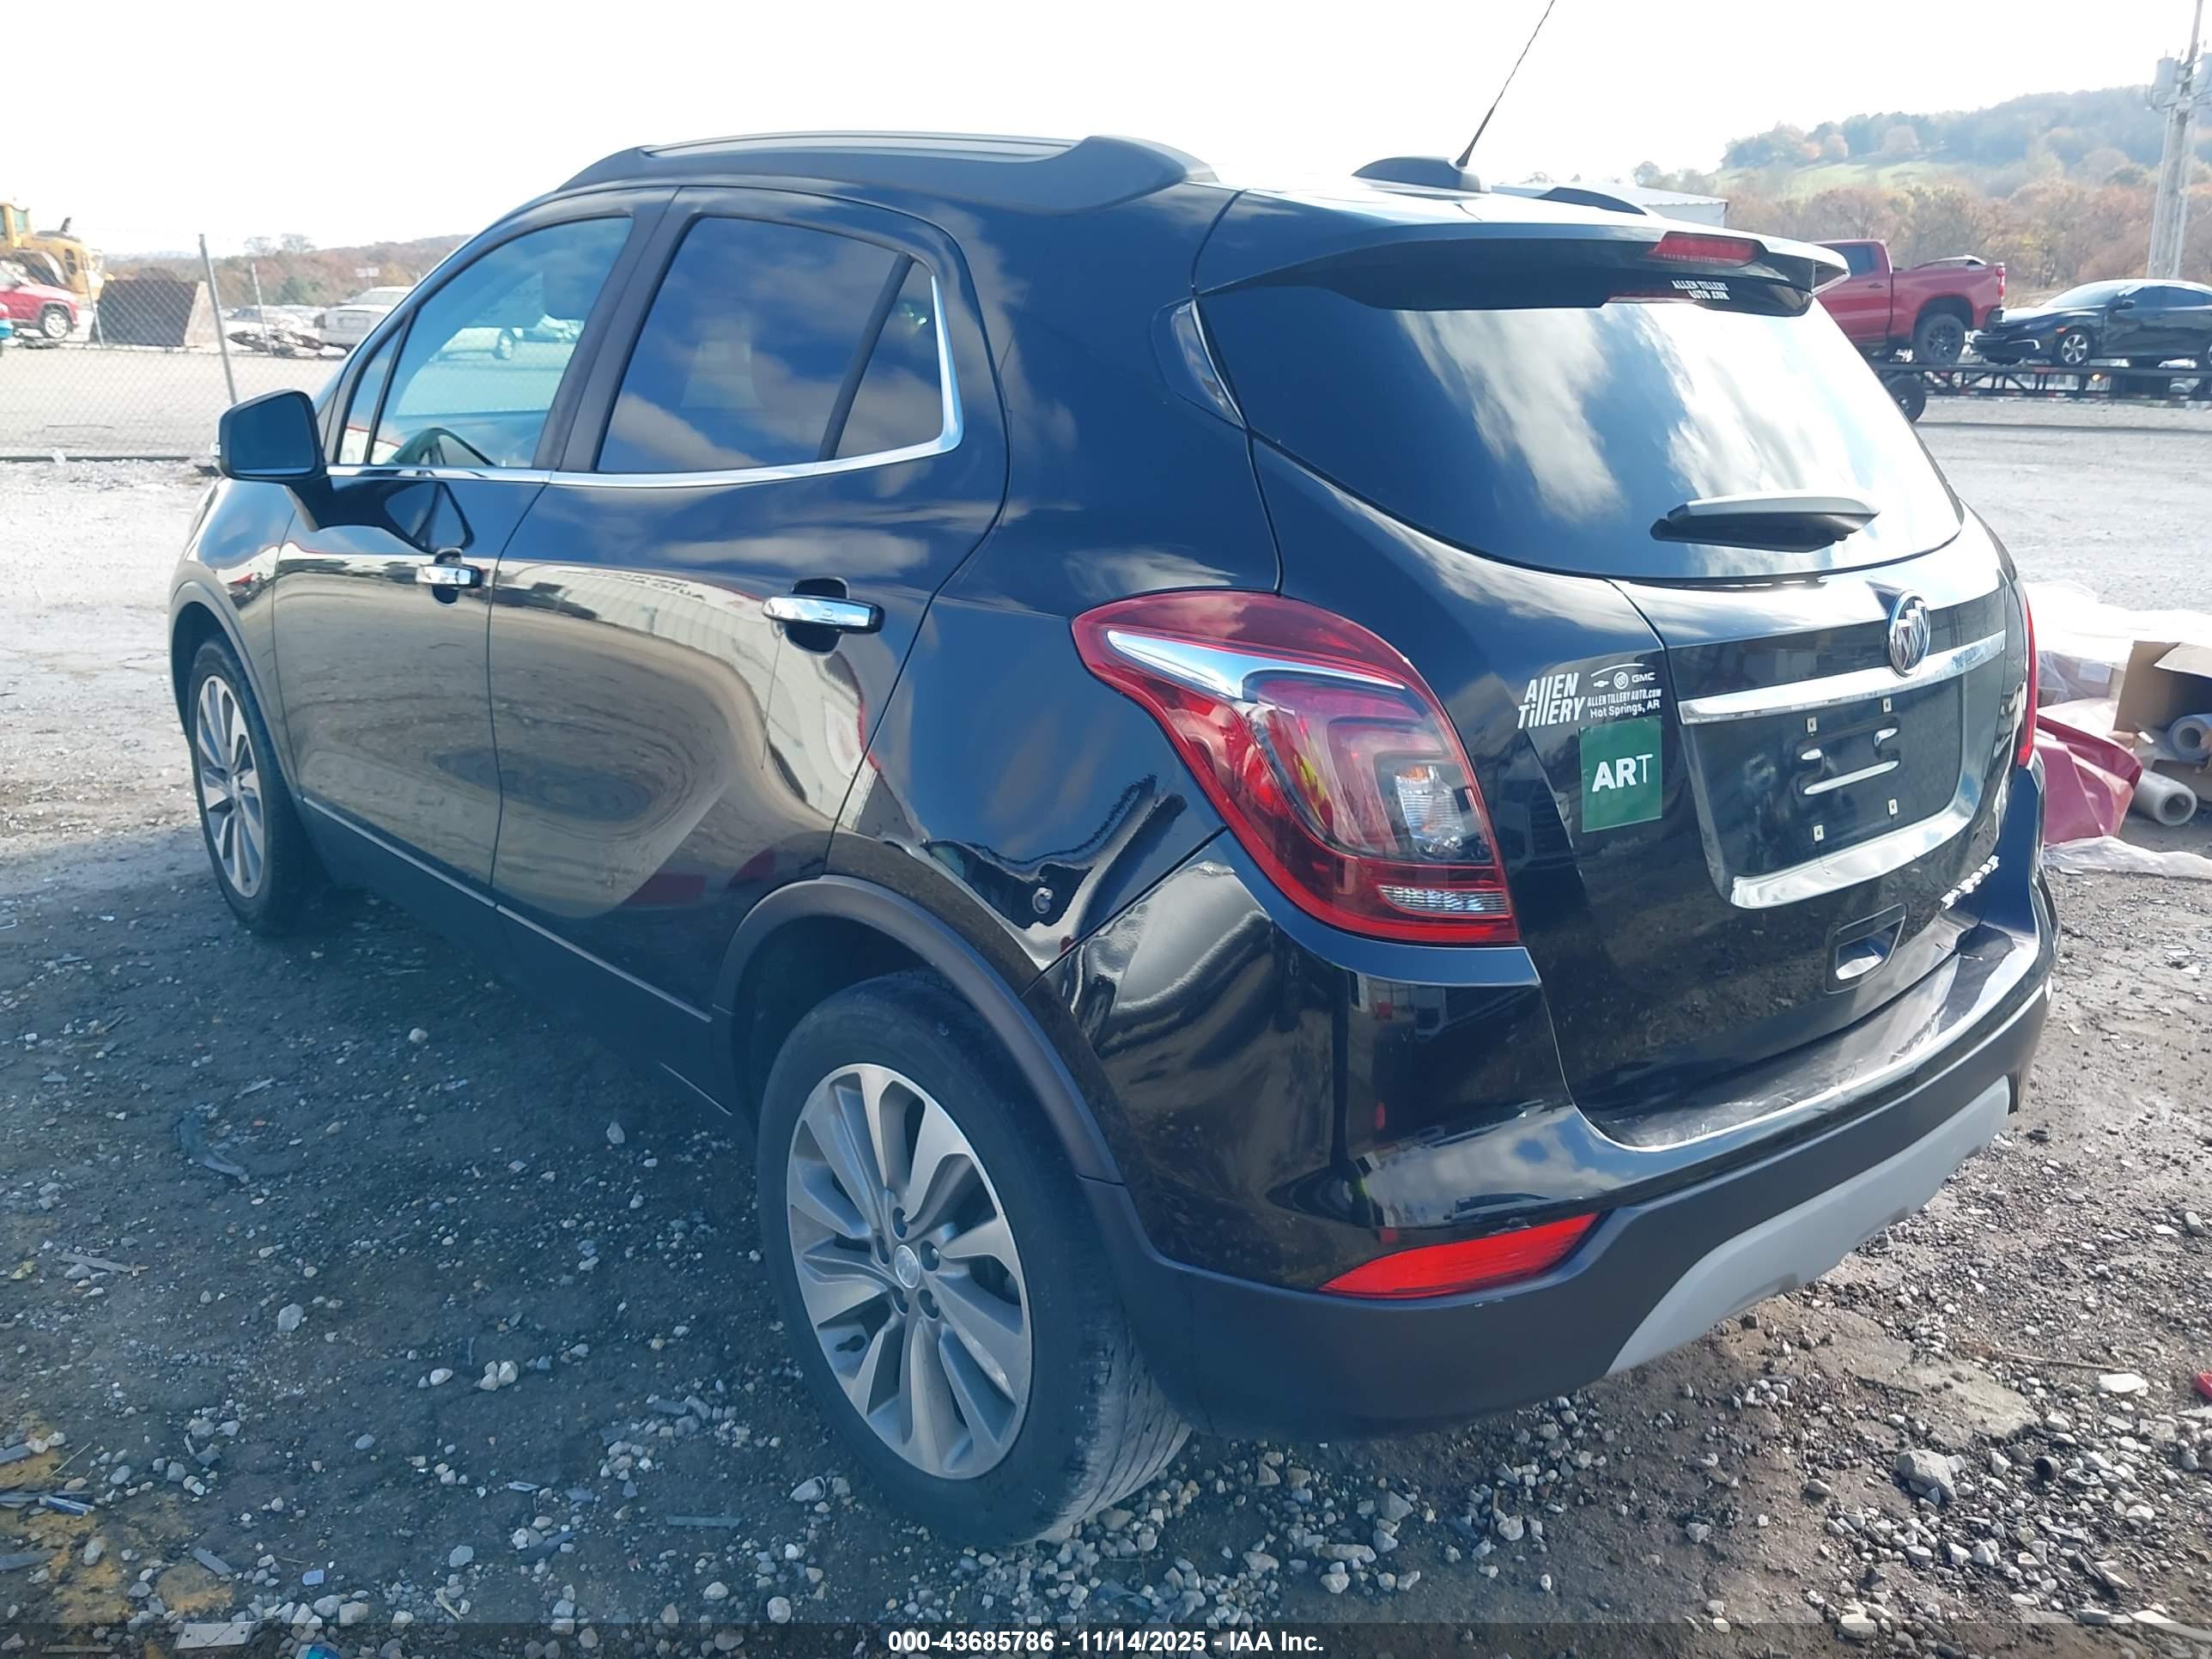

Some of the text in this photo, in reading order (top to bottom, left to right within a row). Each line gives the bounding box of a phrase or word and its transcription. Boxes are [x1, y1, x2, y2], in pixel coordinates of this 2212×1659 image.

[1632, 672, 1656, 684] GMC
[1589, 699, 1661, 719] Hot Springs, AR
[1592, 753, 1654, 793] ART
